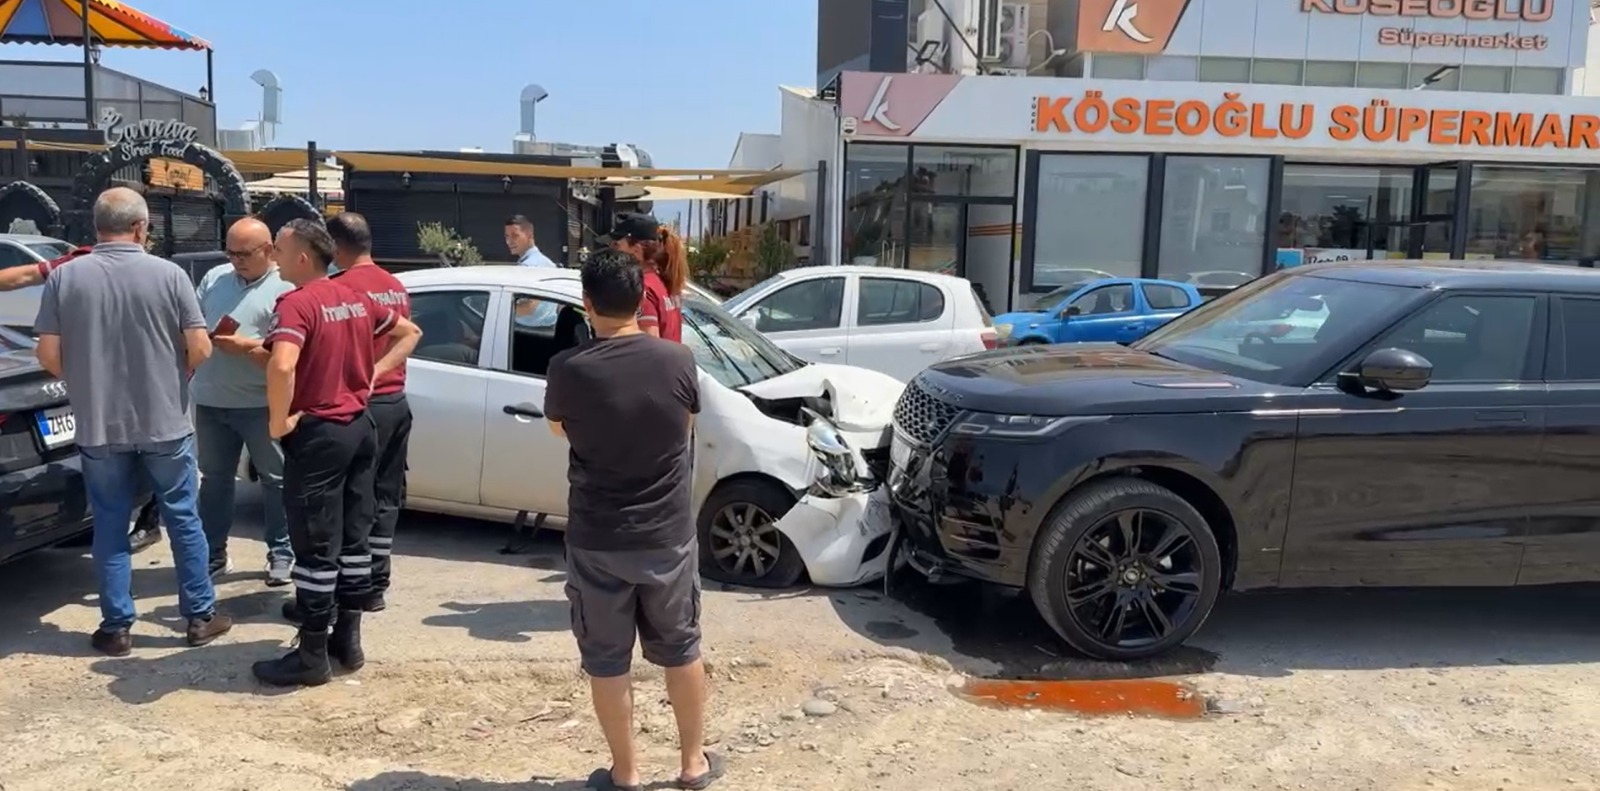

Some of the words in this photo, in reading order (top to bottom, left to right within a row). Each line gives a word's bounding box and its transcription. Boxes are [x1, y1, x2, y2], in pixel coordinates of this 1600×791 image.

[1378, 27, 1547, 49] Süpermarket
[1036, 90, 1313, 139] KÖSEOĞLU
[1328, 98, 1600, 149] SÜPERMAR
[121, 138, 157, 160] Street
[159, 139, 190, 158] Food
